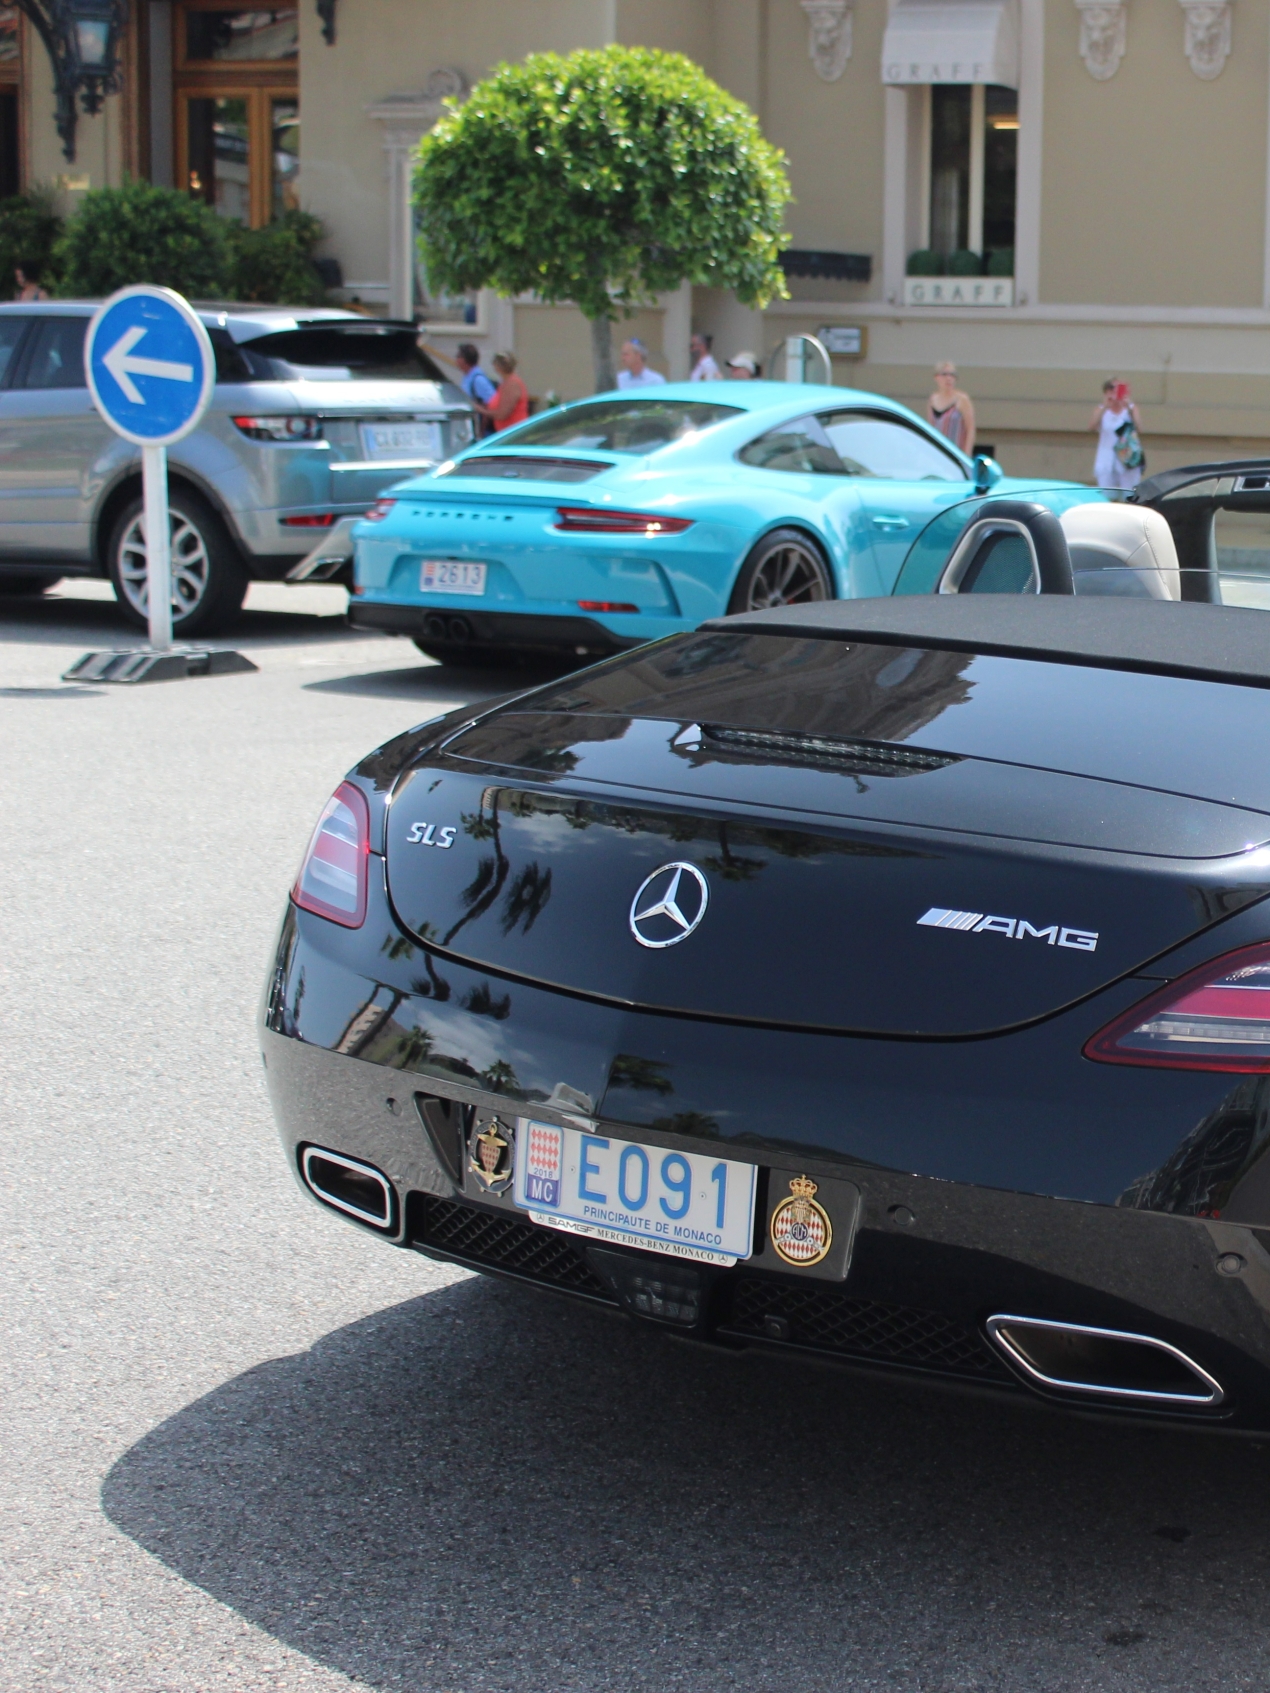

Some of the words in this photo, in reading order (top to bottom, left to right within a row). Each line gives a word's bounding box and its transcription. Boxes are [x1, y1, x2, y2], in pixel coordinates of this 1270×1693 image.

[886, 62, 982, 80] GRAFF
[912, 284, 1004, 301] GRAFF
[438, 564, 481, 585] 2613
[406, 821, 457, 849] SLS
[971, 914, 1099, 952] AMG
[531, 1177, 553, 1203] MC
[577, 1133, 729, 1230] E091
[583, 1205, 651, 1230] PRINCIPAUTE
[655, 1221, 669, 1235] DE
[673, 1225, 723, 1246] MONACO
[597, 1227, 671, 1253] MERCEDES-BENZ
[672, 1244, 714, 1262] MONACO
